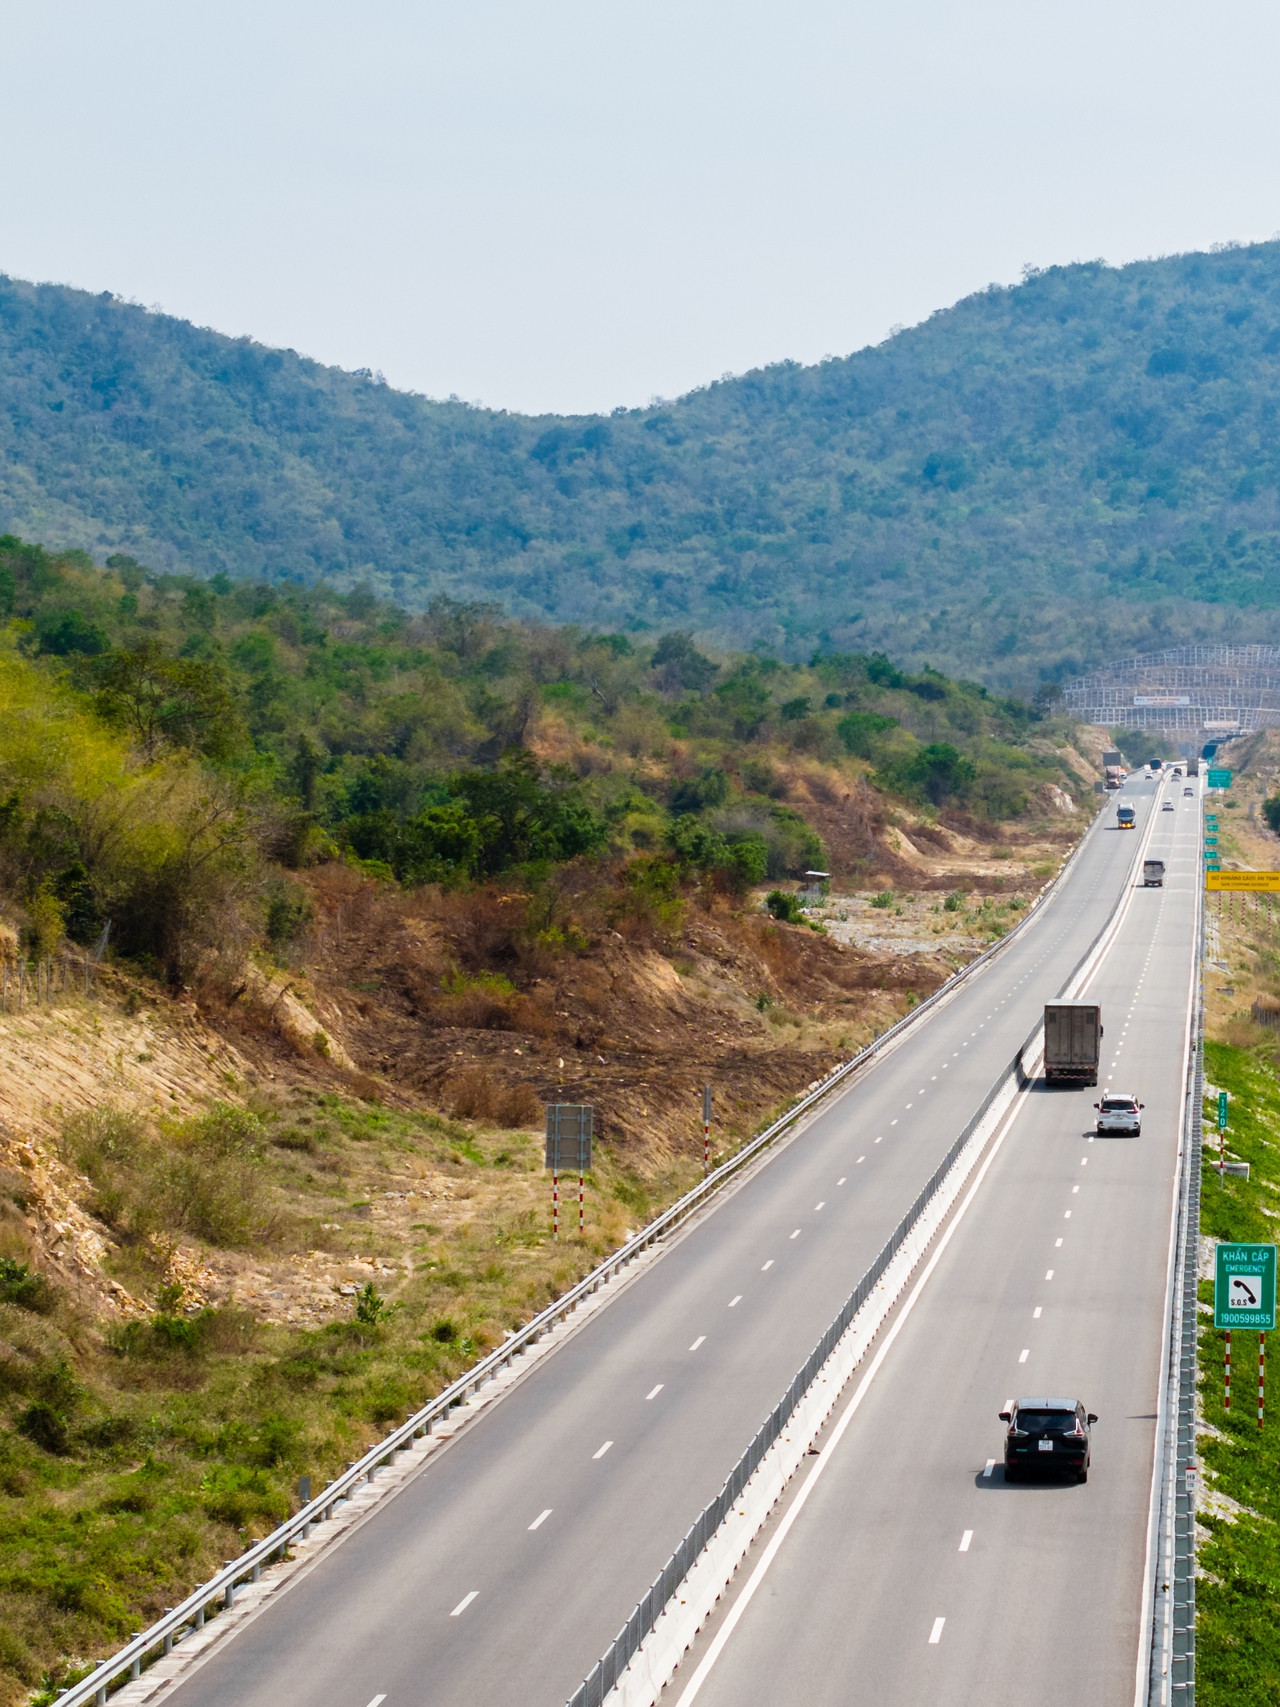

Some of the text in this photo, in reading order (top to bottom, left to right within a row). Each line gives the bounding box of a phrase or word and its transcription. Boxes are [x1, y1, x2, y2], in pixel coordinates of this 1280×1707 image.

[1222, 1248, 1270, 1262] KHẨN CẤP
[1225, 1265, 1266, 1273] EMERGENCY
[1220, 1313, 1271, 1324] 1900599855
